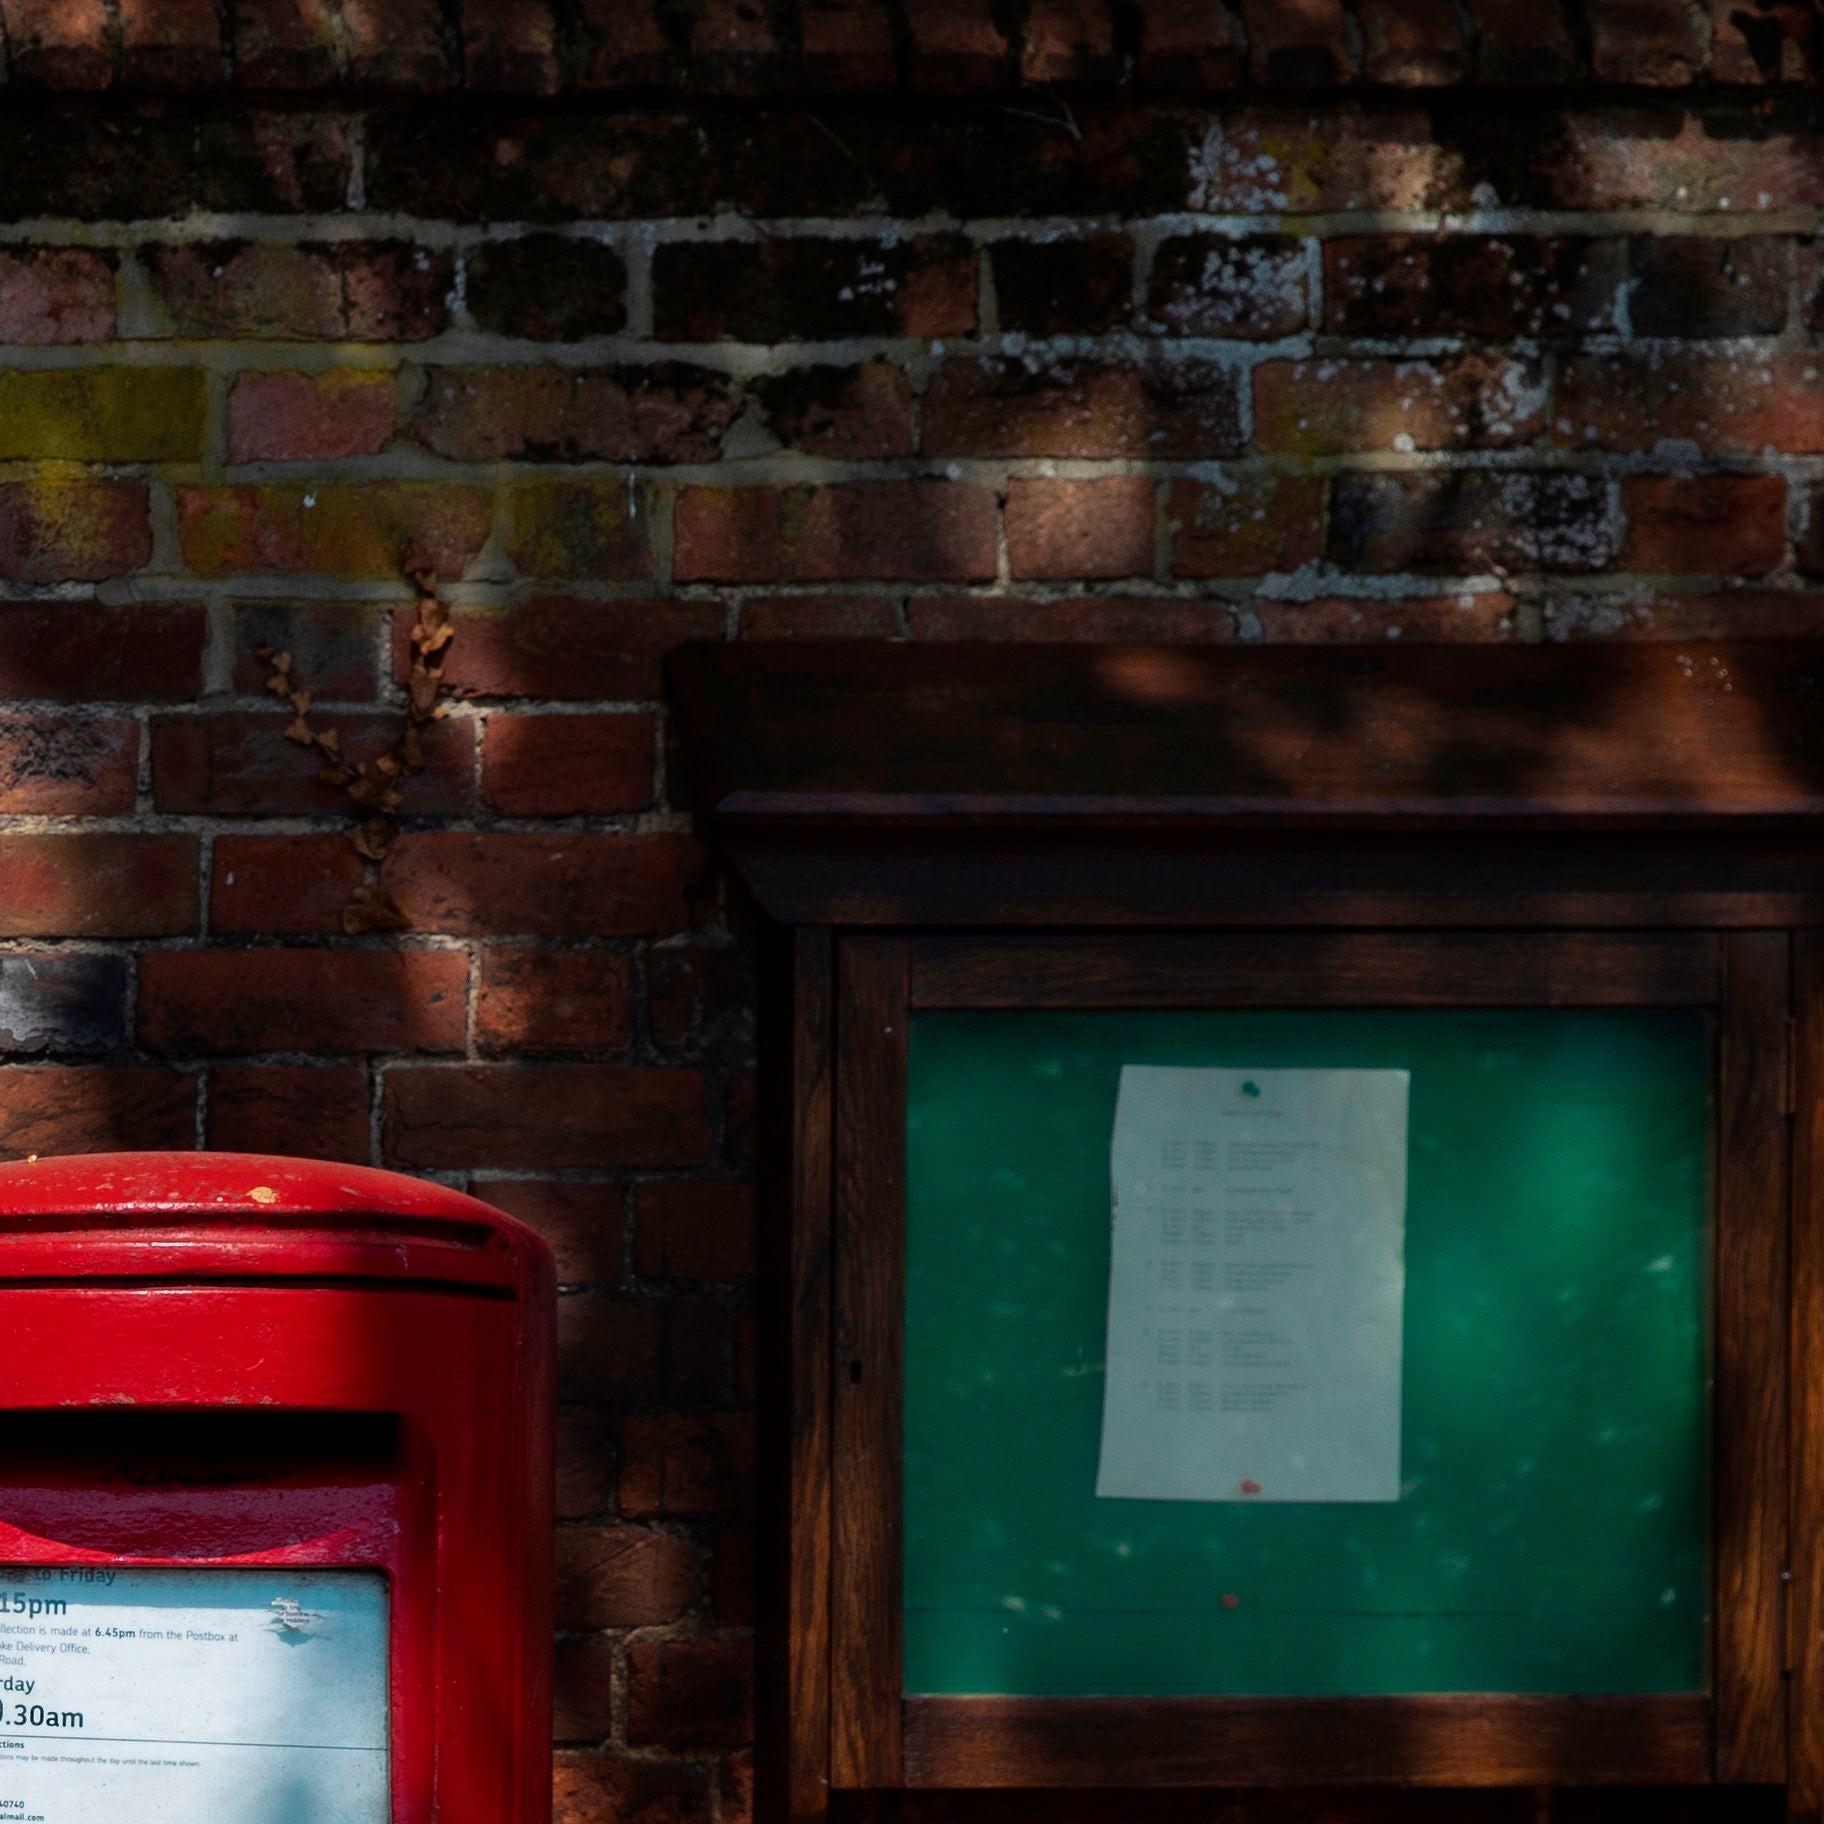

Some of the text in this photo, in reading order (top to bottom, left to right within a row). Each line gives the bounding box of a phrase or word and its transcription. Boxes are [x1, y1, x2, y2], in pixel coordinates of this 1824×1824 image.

[60, 1567, 117, 1587] Friday
[38, 1625, 46, 1636] is
[50, 1625, 78, 1637] made
[81, 1627, 92, 1637] at
[94, 1628, 136, 1641] 6.45pm
[139, 1629, 163, 1640] from
[166, 1629, 183, 1641] the
[186, 1630, 226, 1642] Postbox
[229, 1632, 239, 1642] at
[16, 1641, 57, 1655] Delivery
